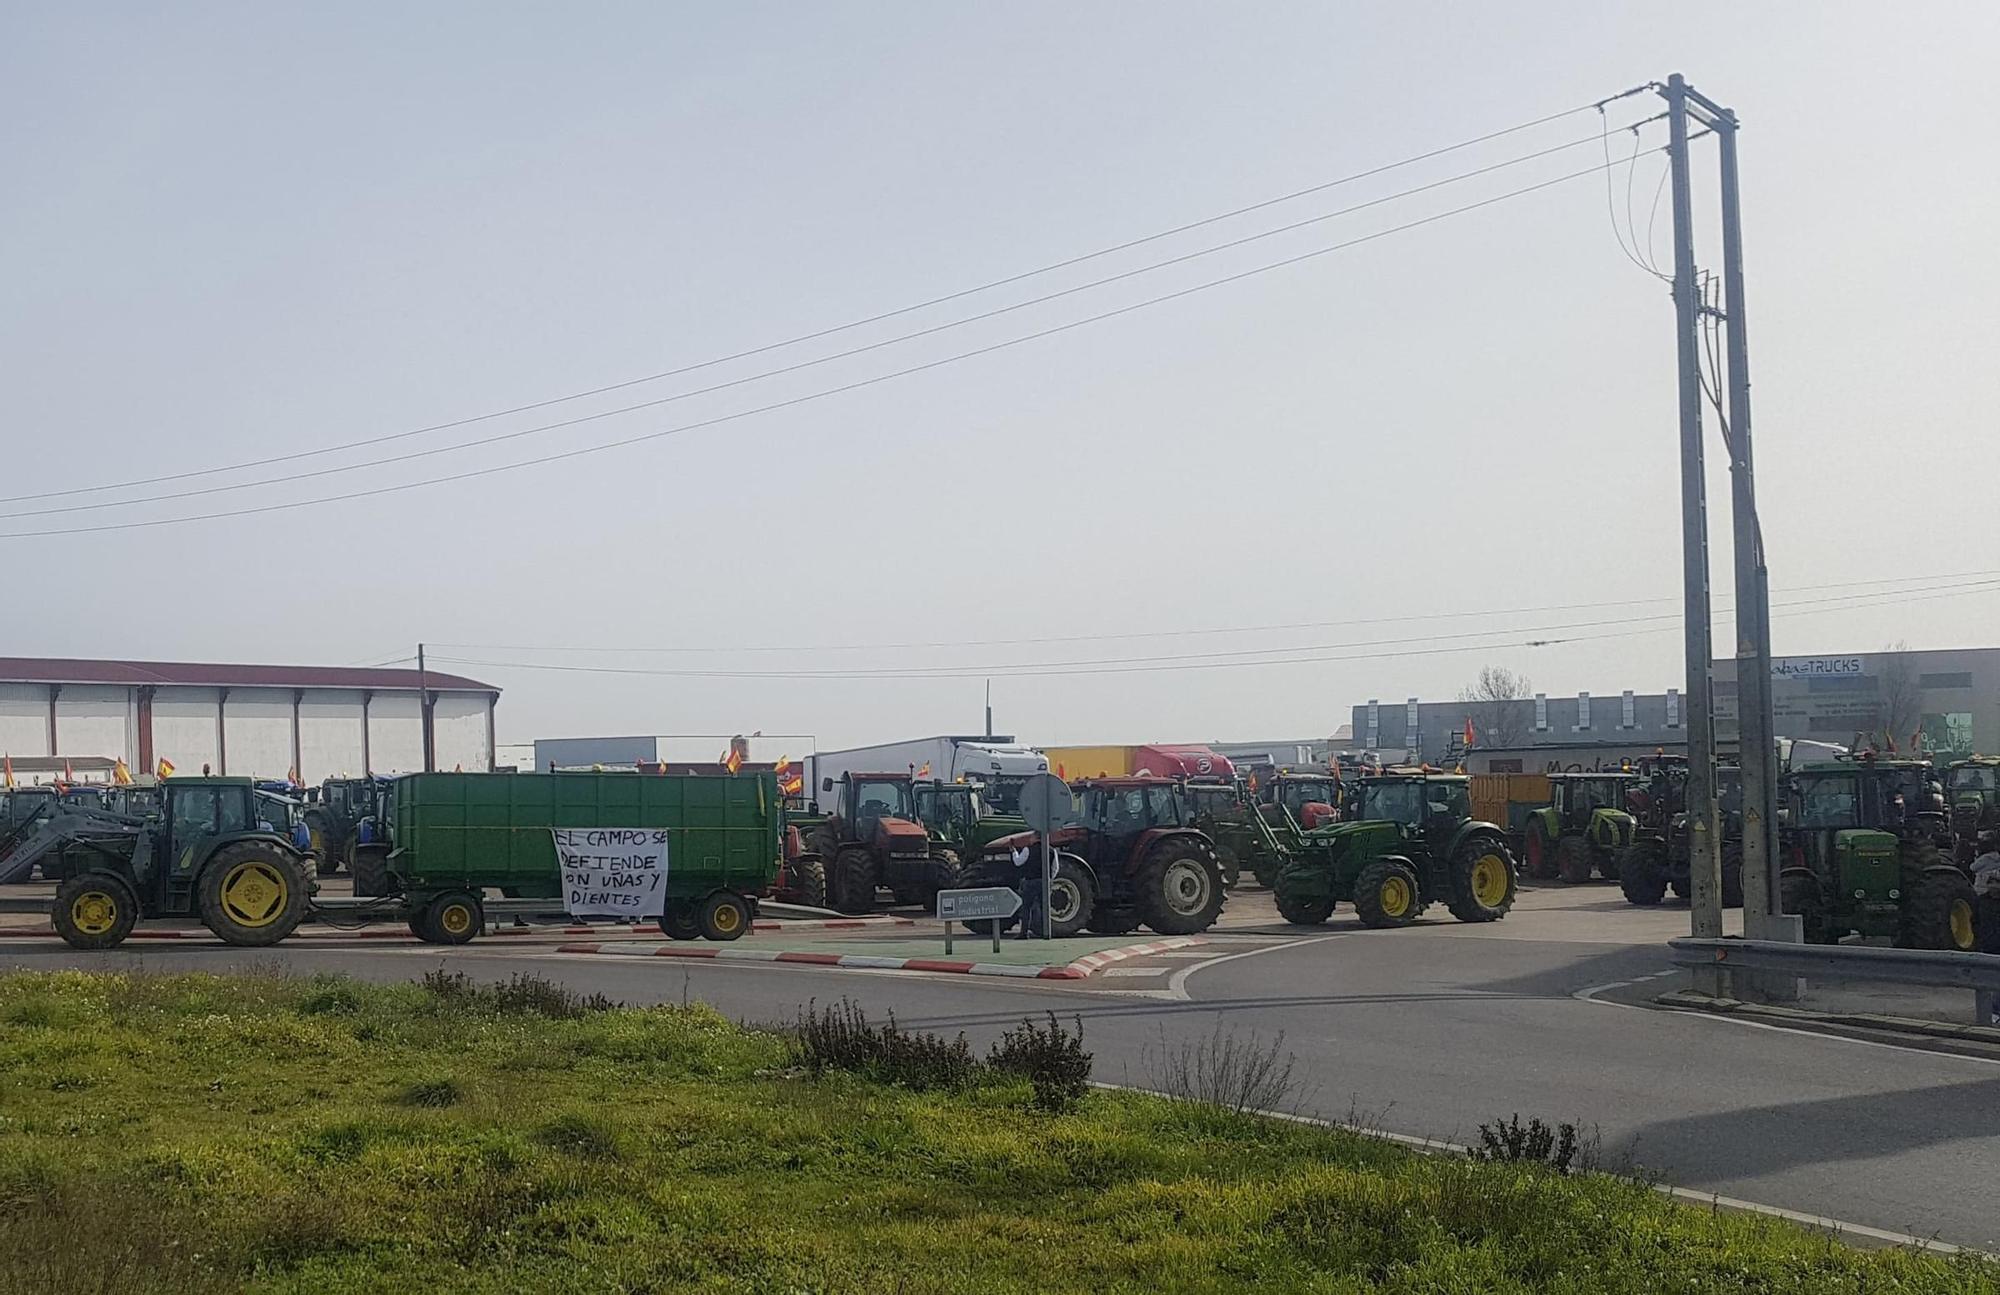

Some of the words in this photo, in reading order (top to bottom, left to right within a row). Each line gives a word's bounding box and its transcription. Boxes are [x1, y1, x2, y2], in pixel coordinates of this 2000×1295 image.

[554, 830, 580, 846] EL
[586, 830, 647, 847] CAMPO
[652, 831, 667, 844] SE
[561, 850, 657, 871] DEFIENDE
[602, 871, 644, 888] UÑAS
[571, 888, 642, 906] DIENTES
